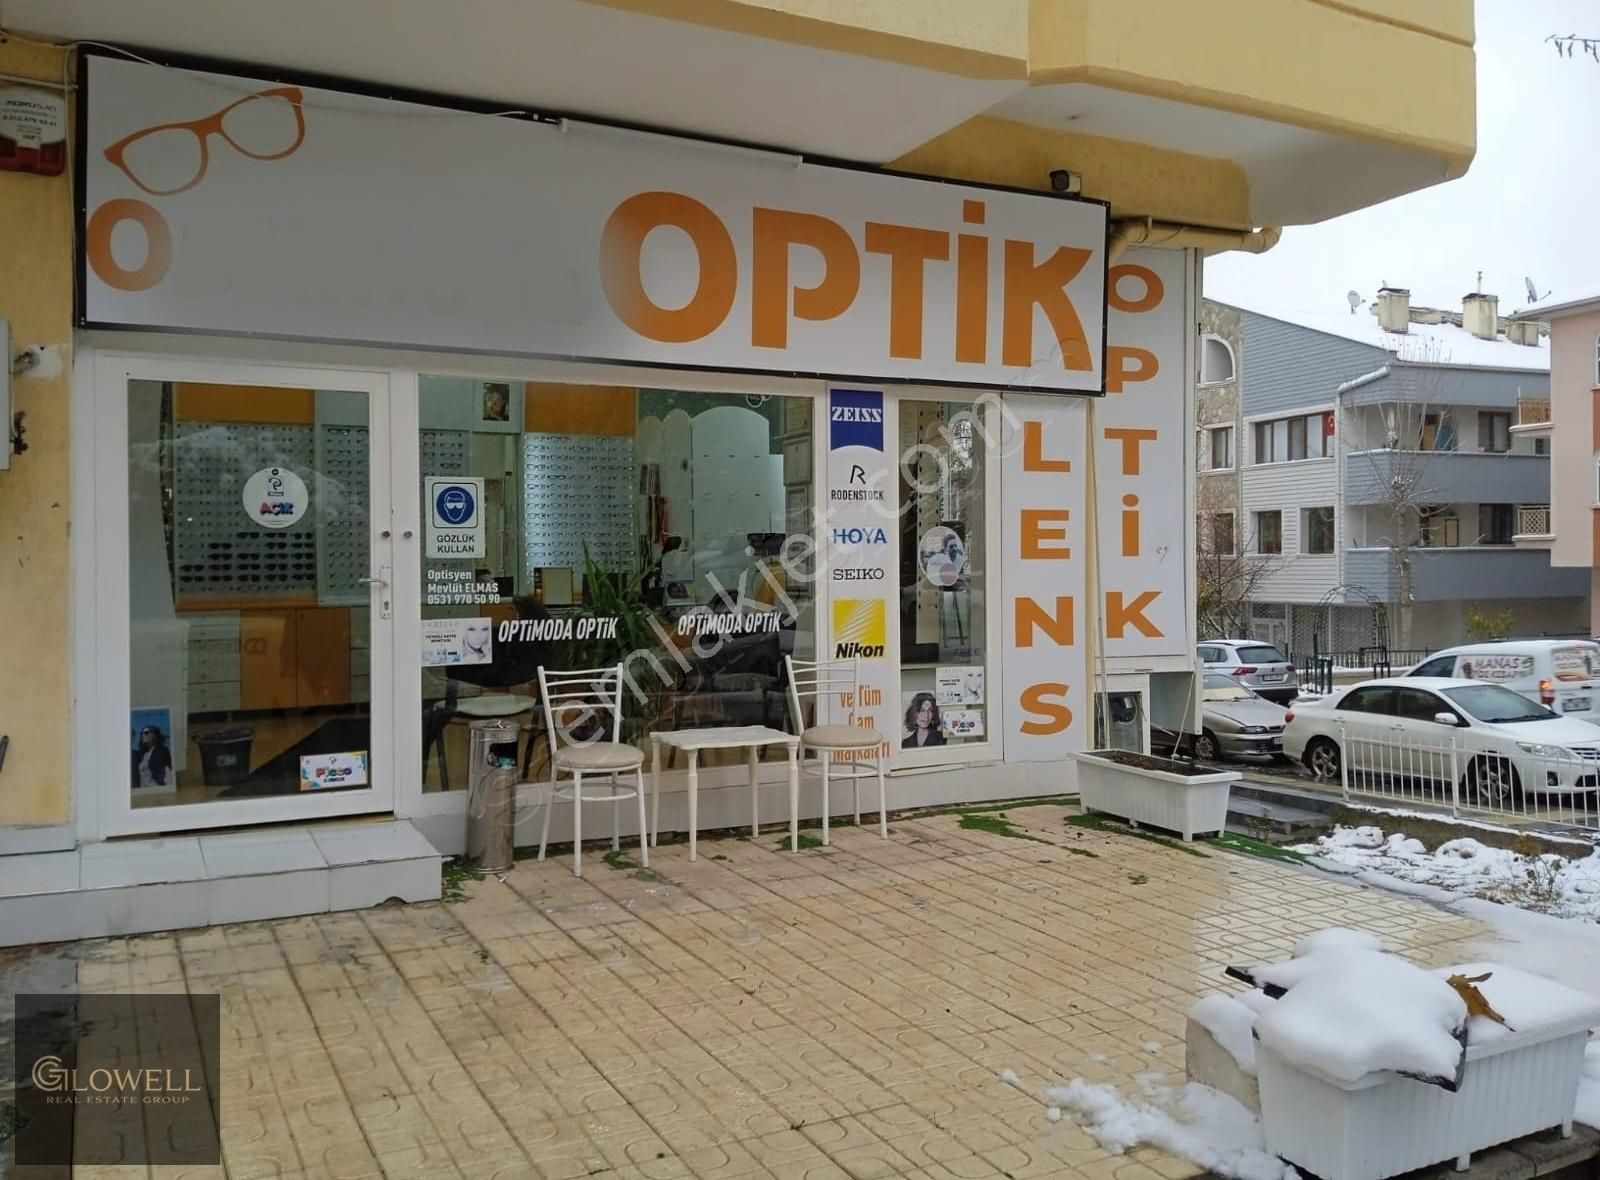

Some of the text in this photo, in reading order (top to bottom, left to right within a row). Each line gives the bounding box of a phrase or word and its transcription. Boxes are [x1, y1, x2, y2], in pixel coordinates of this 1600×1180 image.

[600, 190, 1094, 372] OPTİK
[831, 406, 883, 423] ZEISS
[830, 489, 885, 501] RODENSTOCK
[436, 533, 475, 543] GÖZLÜK
[832, 528, 888, 545] HOYA
[437, 544, 475, 553] KULLAN
[427, 569, 472, 581] Optisyen
[832, 568, 885, 581] SEIKO
[1014, 420, 1075, 737] LENS
[427, 582, 499, 593] Mevlüt ELMAS
[427, 594, 454, 605] 0531
[835, 642, 885, 659] Nikon
